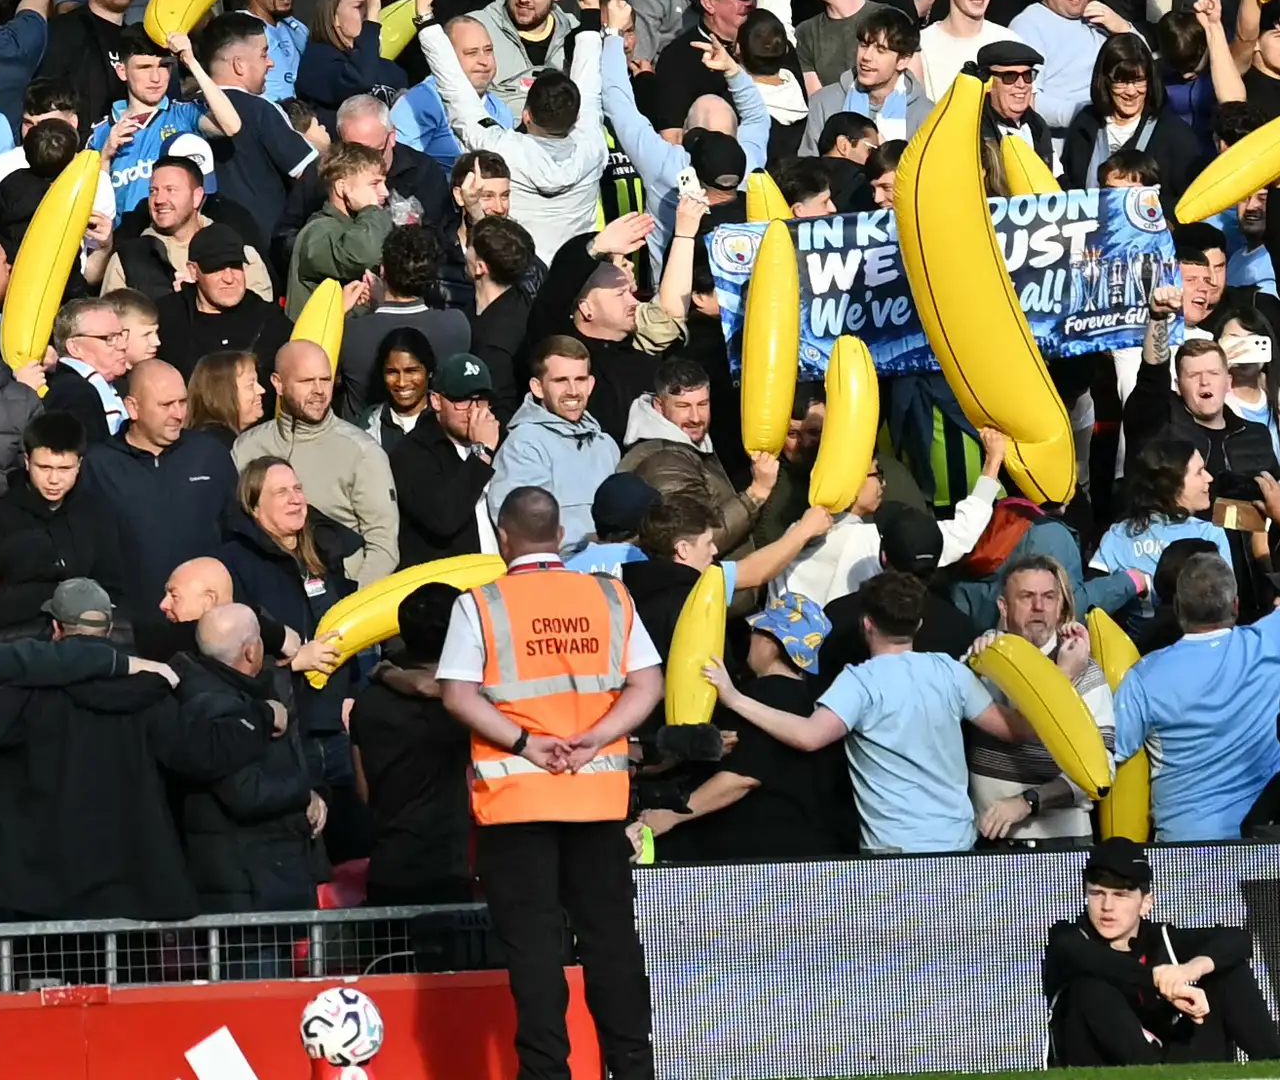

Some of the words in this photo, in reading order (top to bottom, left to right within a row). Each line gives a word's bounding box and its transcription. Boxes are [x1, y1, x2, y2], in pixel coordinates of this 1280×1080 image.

[798, 216, 844, 251] IN
[806, 244, 901, 295] WE
[996, 219, 1100, 273] UST
[810, 291, 912, 337] We've
[1133, 538, 1165, 557] DOK
[532, 616, 590, 635] CROWD
[526, 637, 599, 657] STEWARD
